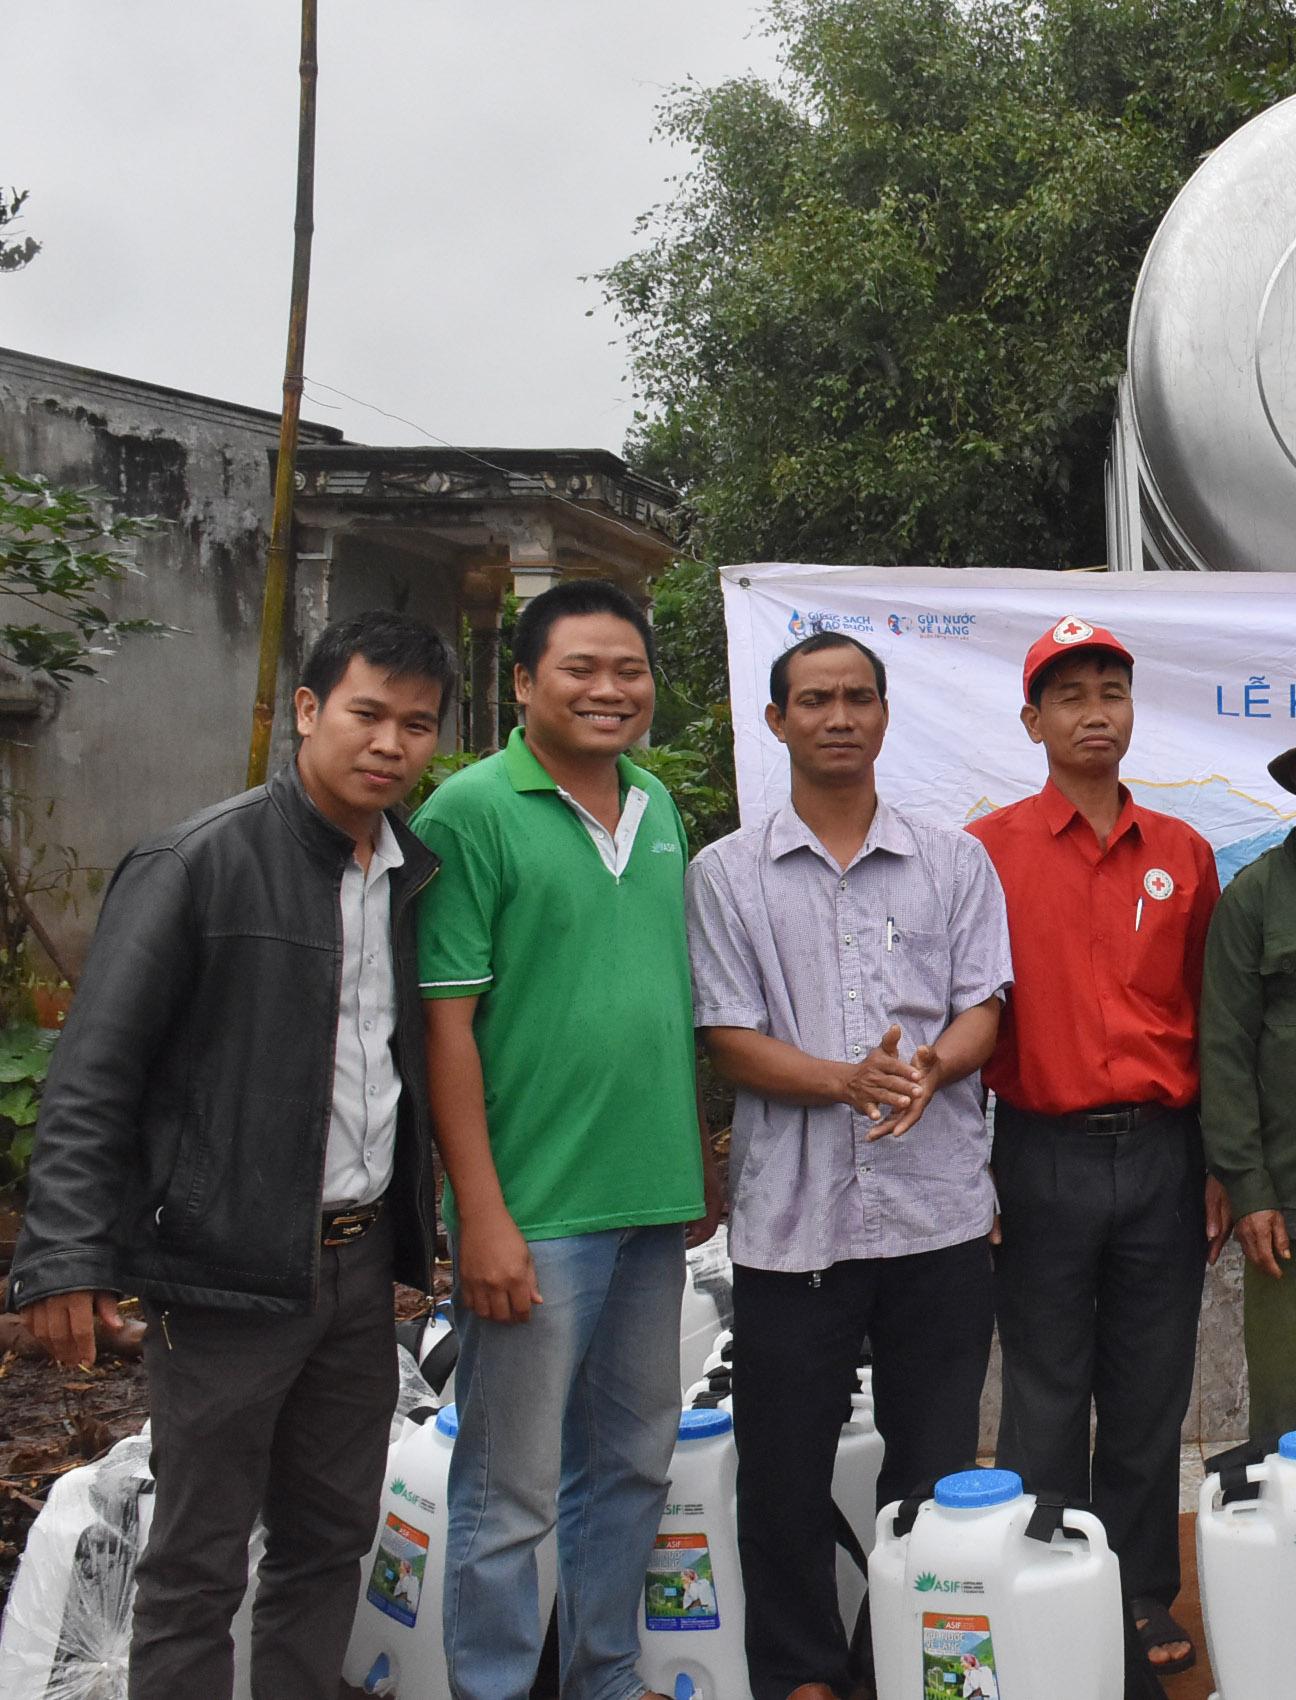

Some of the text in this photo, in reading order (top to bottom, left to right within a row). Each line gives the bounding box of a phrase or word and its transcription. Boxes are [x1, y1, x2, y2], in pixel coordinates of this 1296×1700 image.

[1217, 676, 1271, 718] LỄ
[662, 1504, 683, 1515] SIF
[933, 1580, 961, 1593] ASIF
